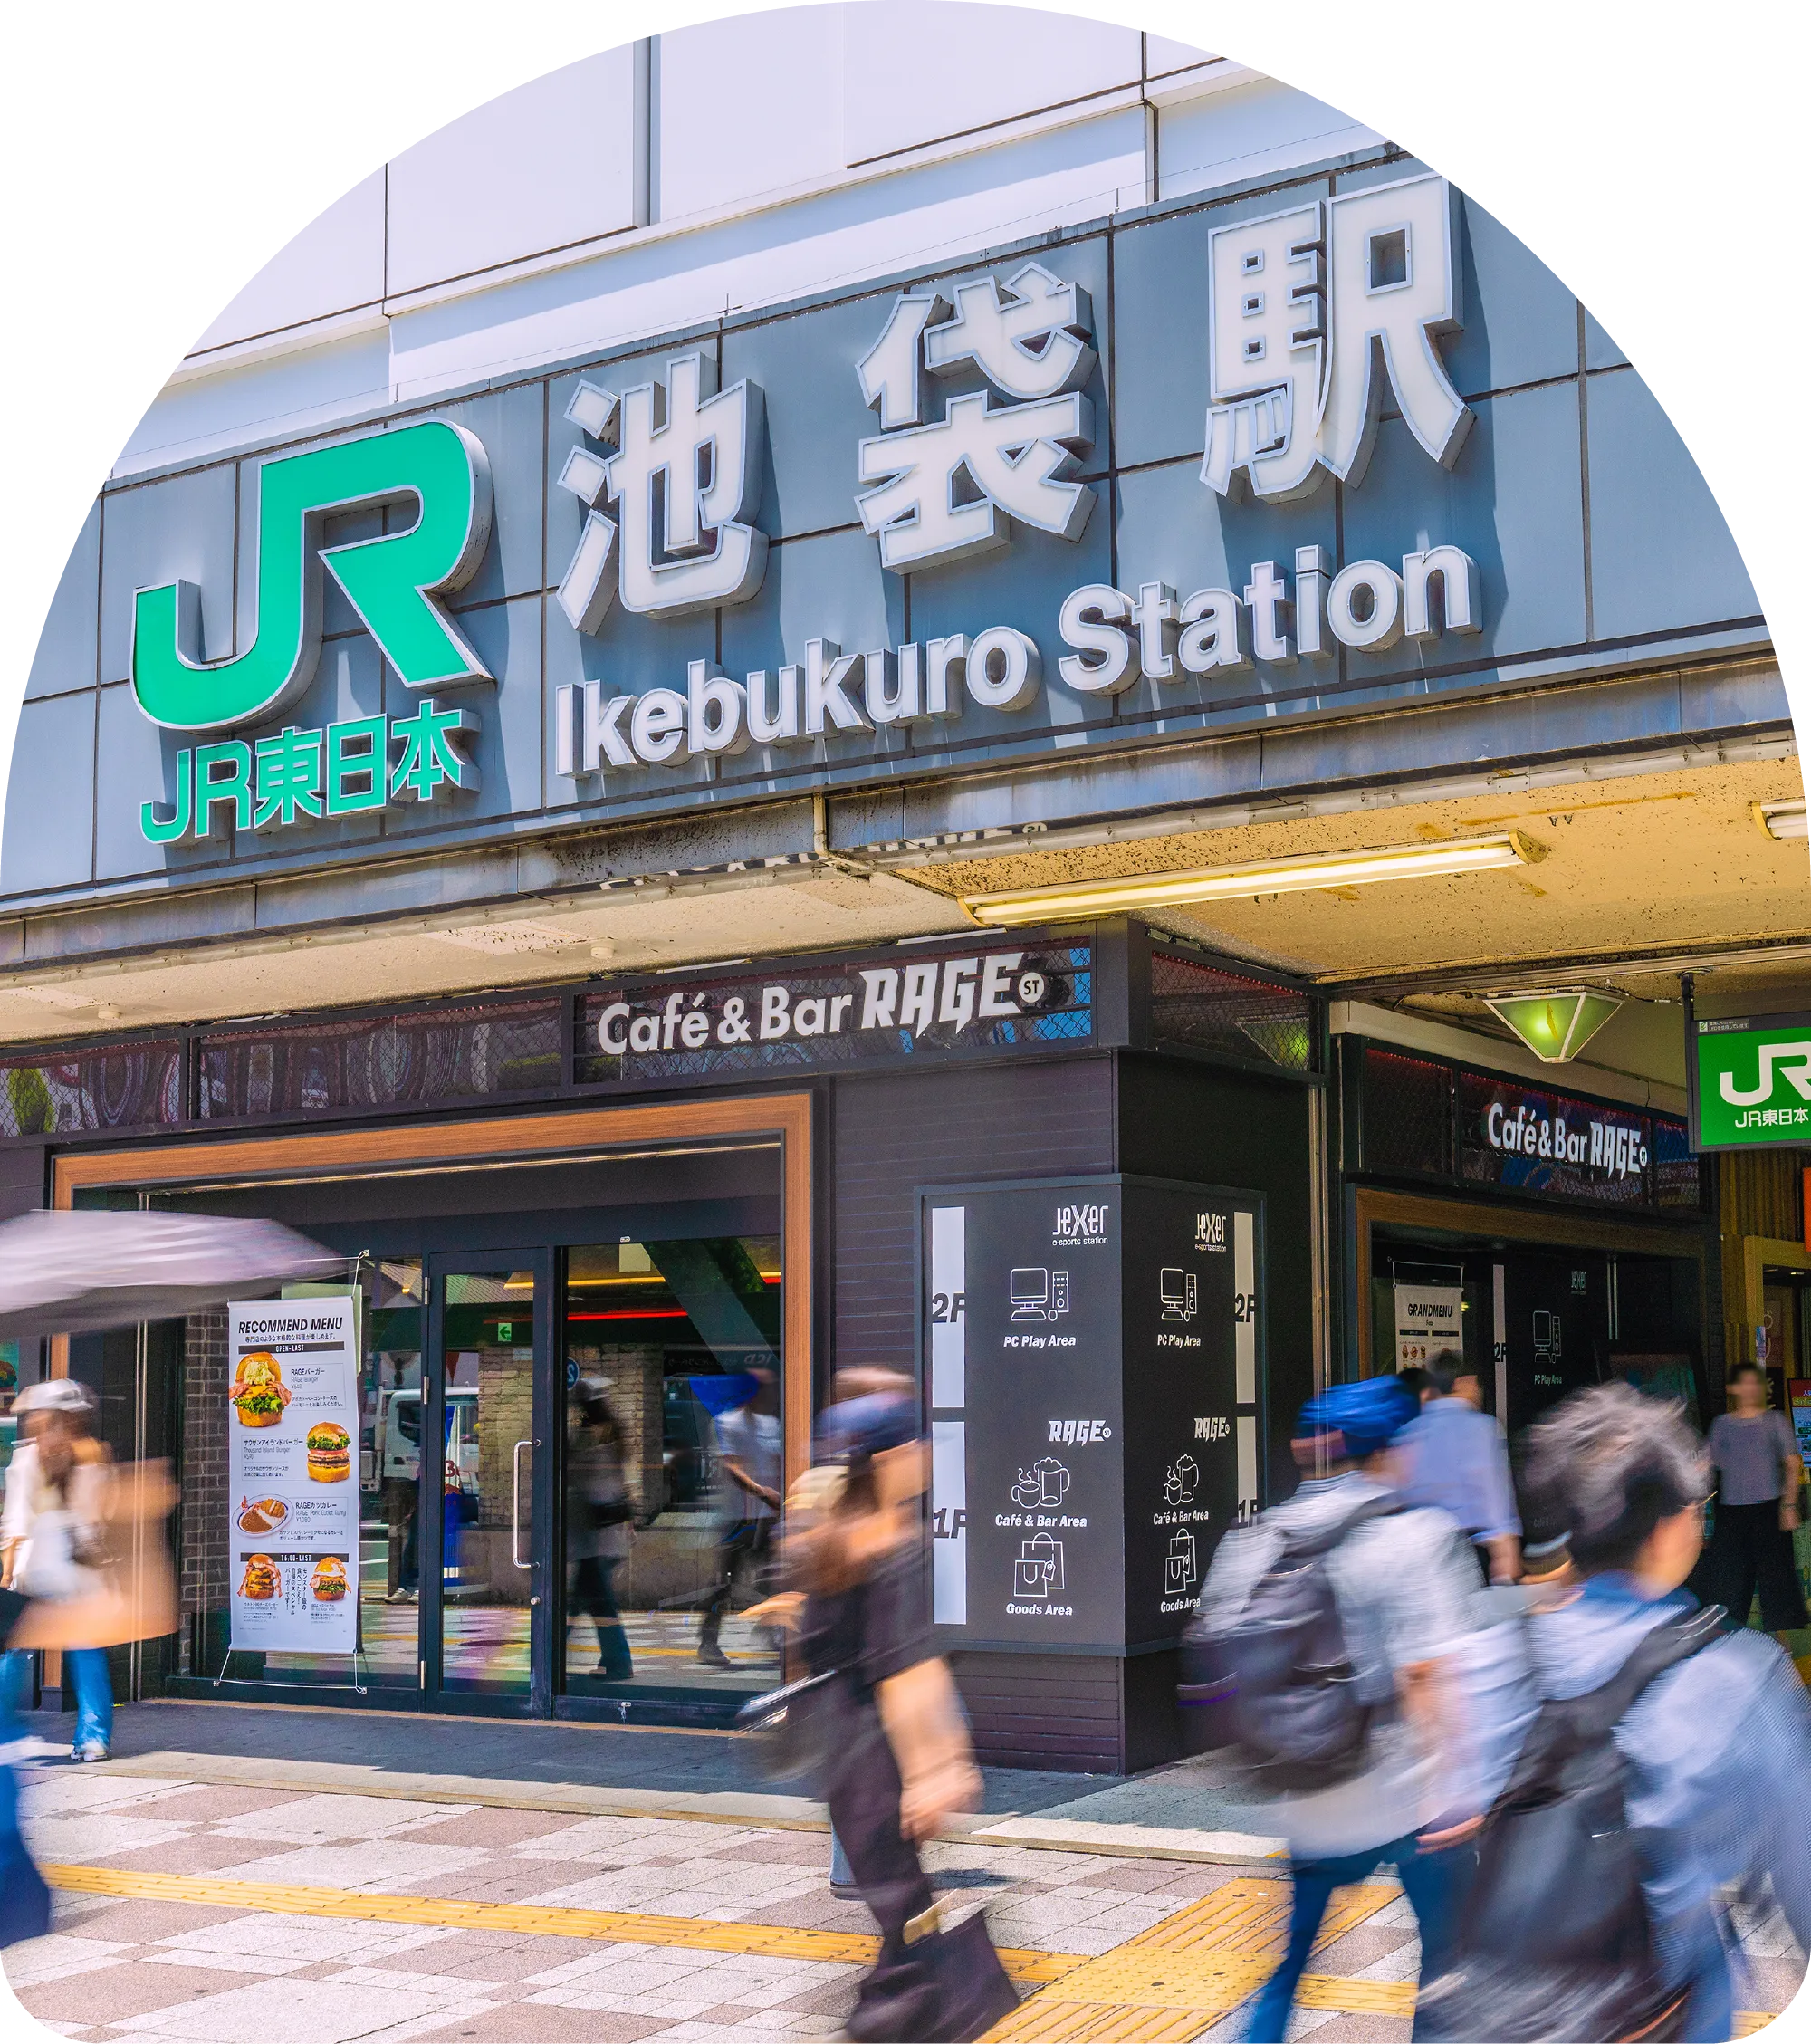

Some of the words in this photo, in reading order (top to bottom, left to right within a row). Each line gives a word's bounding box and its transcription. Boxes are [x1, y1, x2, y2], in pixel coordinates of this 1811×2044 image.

[556, 173, 1472, 632] 池袋駅
[130, 418, 493, 730] JR
[555, 626, 1039, 778] Ikebukuro
[1059, 544, 1480, 696] Station
[140, 699, 473, 844] JR東日本
[598, 991, 709, 1055] Café
[717, 1004, 750, 1043] &
[761, 987, 852, 1038] Bar
[859, 953, 1026, 1038] RAGE
[1022, 978, 1040, 996] ST
[1720, 1041, 1811, 1106] JR
[1734, 1107, 1809, 1128] JR東日本
[1489, 1102, 1537, 1154] Café
[1538, 1120, 1551, 1157] &
[1555, 1118, 1587, 1162] Bar
[1590, 1122, 1641, 1180] RAGE
[1052, 1237, 1081, 1247] e-sports
[1083, 1236, 1108, 1245] station
[1212, 1244, 1227, 1252] station
[932, 1292, 967, 1323] 2F
[1234, 1292, 1256, 1323] 2F
[1408, 1303, 1452, 1317] GRANDMENU
[238, 1319, 308, 1333] RECOMMEND
[311, 1317, 343, 1331] MENU
[275, 1344, 304, 1353] OPEN-LAST
[1003, 1335, 1020, 1348] PC
[1021, 1334, 1046, 1349] Play
[1048, 1334, 1077, 1347] Area
[1157, 1334, 1167, 1346] PC
[1168, 1334, 1183, 1348] Play
[1184, 1334, 1201, 1347] Area
[1049, 1420, 1106, 1446] RAGE
[1193, 1417, 1227, 1442] RAGE
[933, 1508, 968, 1539] 1F
[995, 1514, 1022, 1526] Café
[1024, 1514, 1034, 1527] &
[1037, 1515, 1058, 1527] Bar
[1059, 1515, 1087, 1527] Area
[1153, 1511, 1171, 1525] Café
[1172, 1511, 1177, 1524] &
[1179, 1511, 1192, 1522] Bar
[1193, 1510, 1209, 1521] Area
[1006, 1603, 1042, 1614] Goods
[1045, 1604, 1073, 1616] Area
[1161, 1598, 1183, 1613] Goods
[1184, 1597, 1201, 1609] Area
